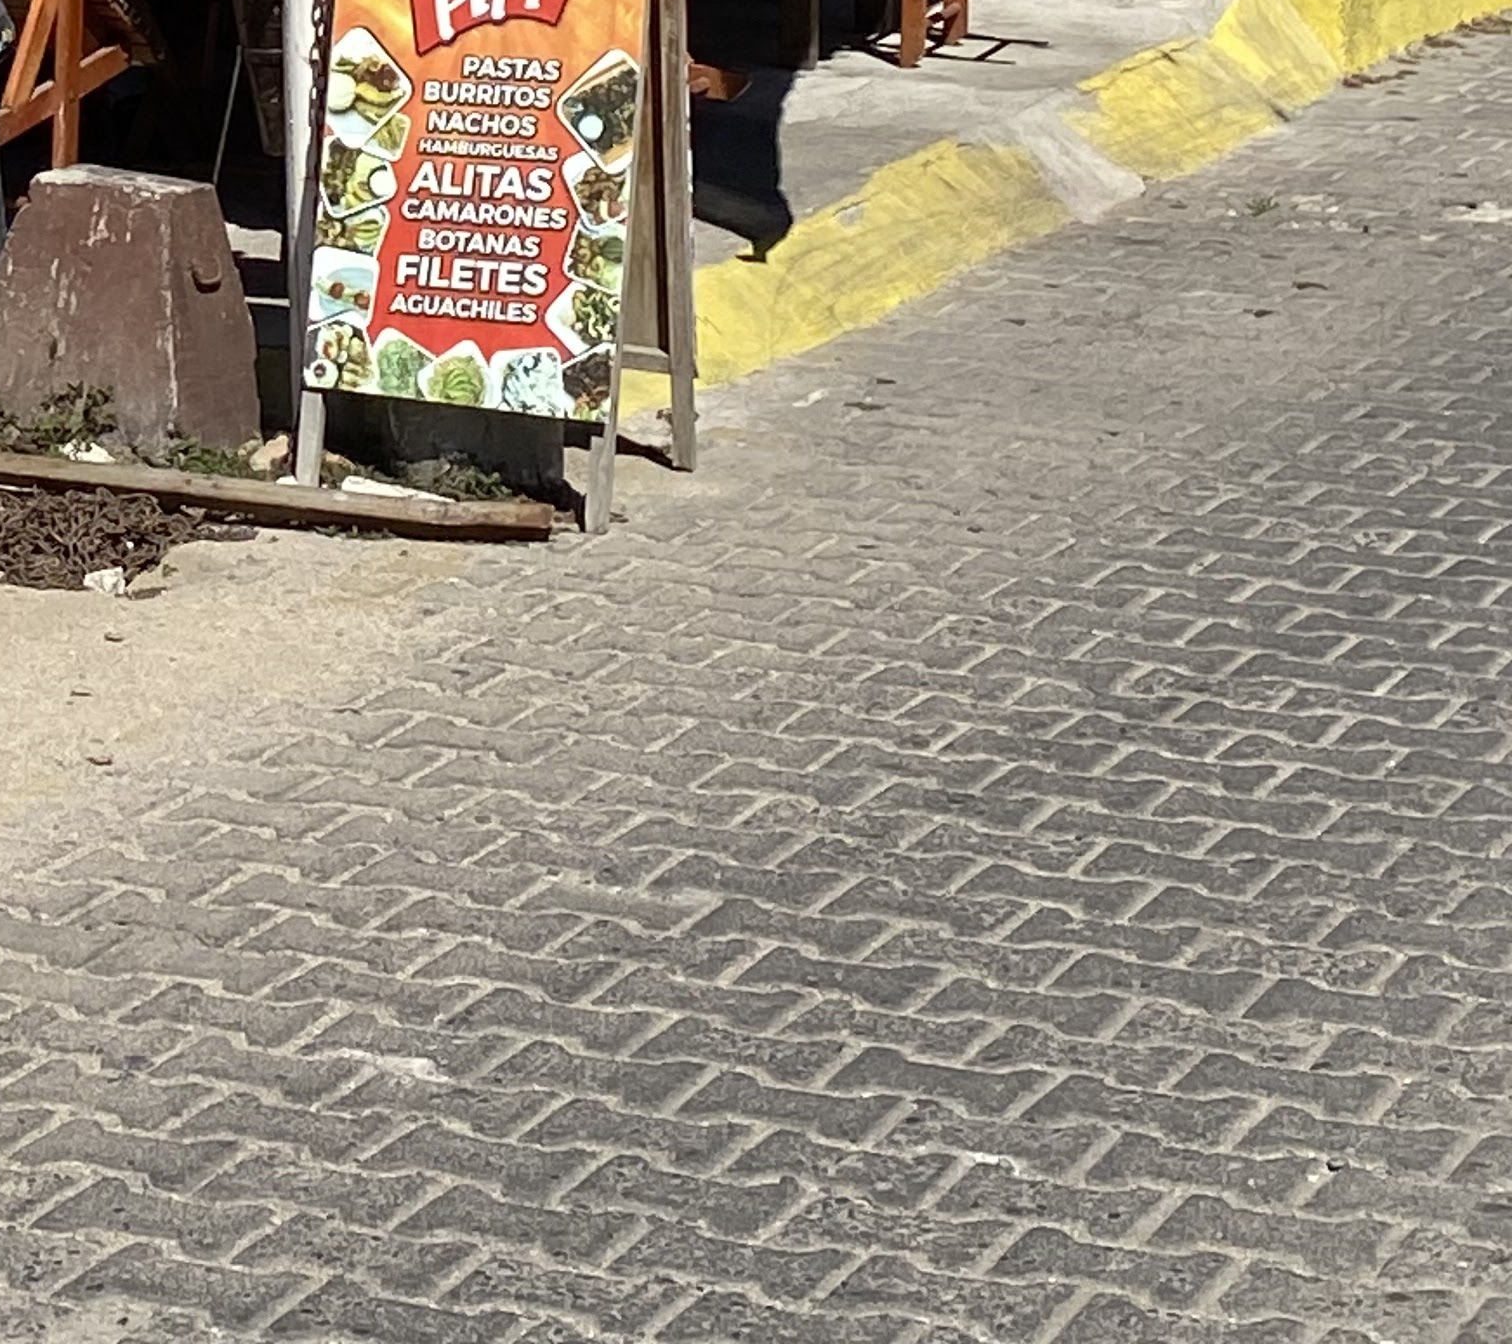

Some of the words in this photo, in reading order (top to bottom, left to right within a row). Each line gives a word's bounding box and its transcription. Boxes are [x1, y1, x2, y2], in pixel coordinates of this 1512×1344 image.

[463, 56, 561, 81] PASTAS
[424, 80, 552, 109] BURRITOS
[428, 110, 537, 137] NACHOS
[419, 138, 559, 161] HAMBURGUESAS
[408, 161, 554, 201] ALITAS
[401, 198, 568, 230] CAMARONES
[418, 228, 541, 258] BOTANAS
[396, 254, 549, 296] FILETES
[389, 293, 538, 324] AGUACHILES
